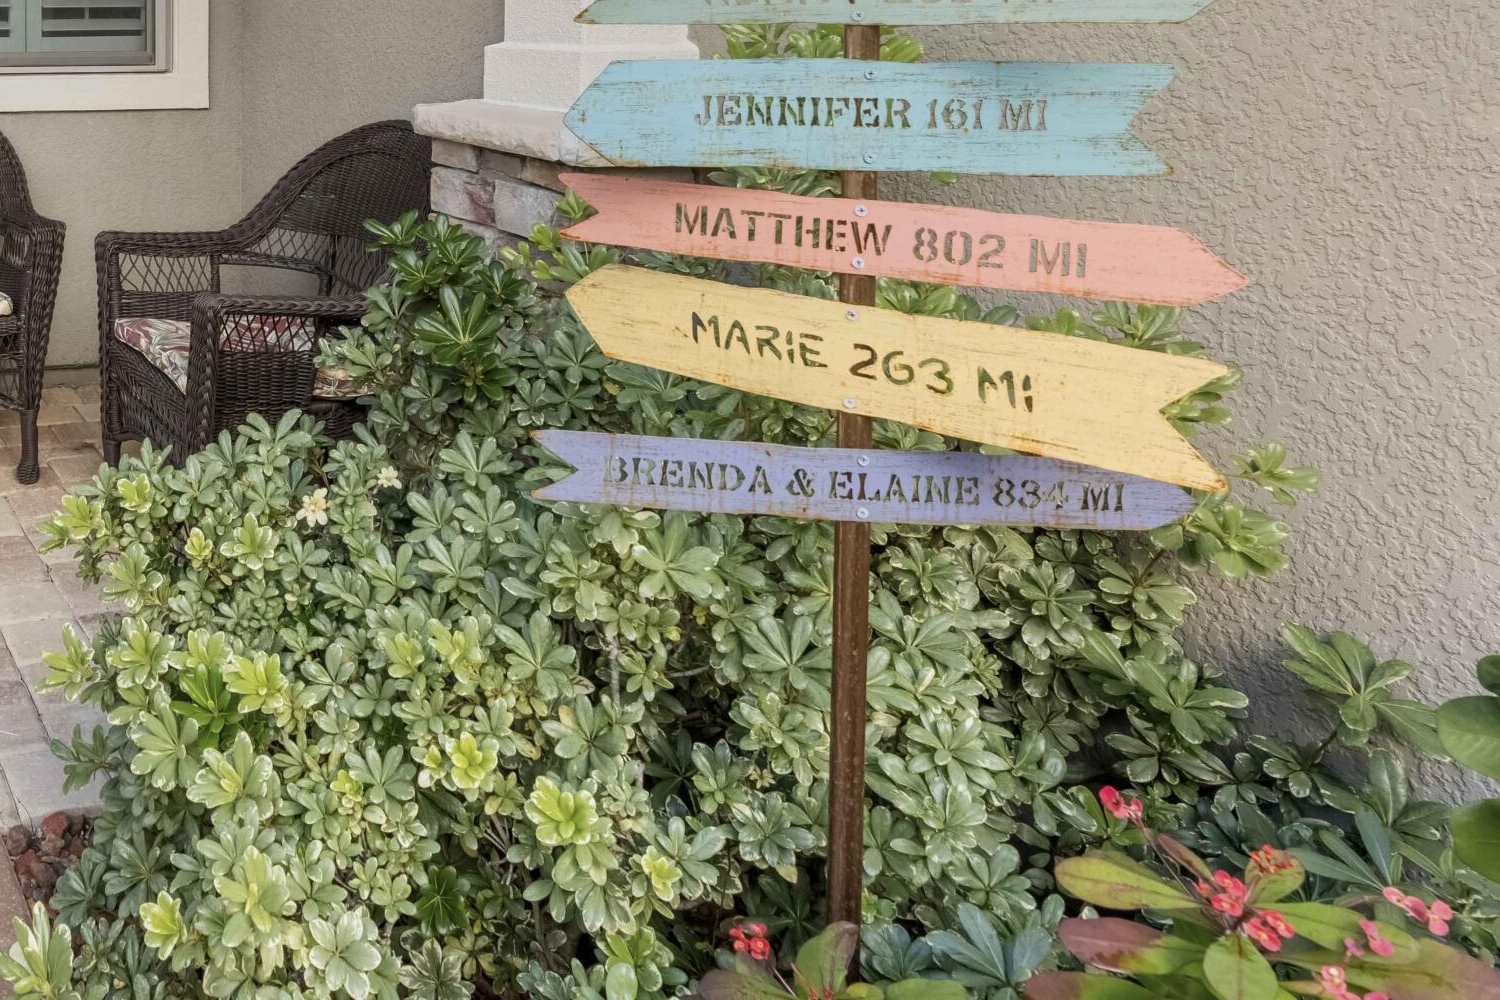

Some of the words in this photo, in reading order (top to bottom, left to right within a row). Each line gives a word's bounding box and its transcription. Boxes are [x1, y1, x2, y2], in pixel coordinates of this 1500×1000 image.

[694, 96, 911, 129] JENNIFER
[925, 97, 984, 131] 161
[999, 99, 1049, 132] MI
[674, 202, 893, 256] MATTHEW
[912, 226, 1006, 270] 802
[1029, 238, 1088, 279] MI
[690, 311, 828, 370] MARIE
[849, 343, 955, 396] 263
[603, 455, 774, 494] BRENDA
[786, 468, 815, 498] &
[828, 471, 980, 507] ELAINE
[991, 477, 1070, 510] 834
[1080, 481, 1126, 513] MI
